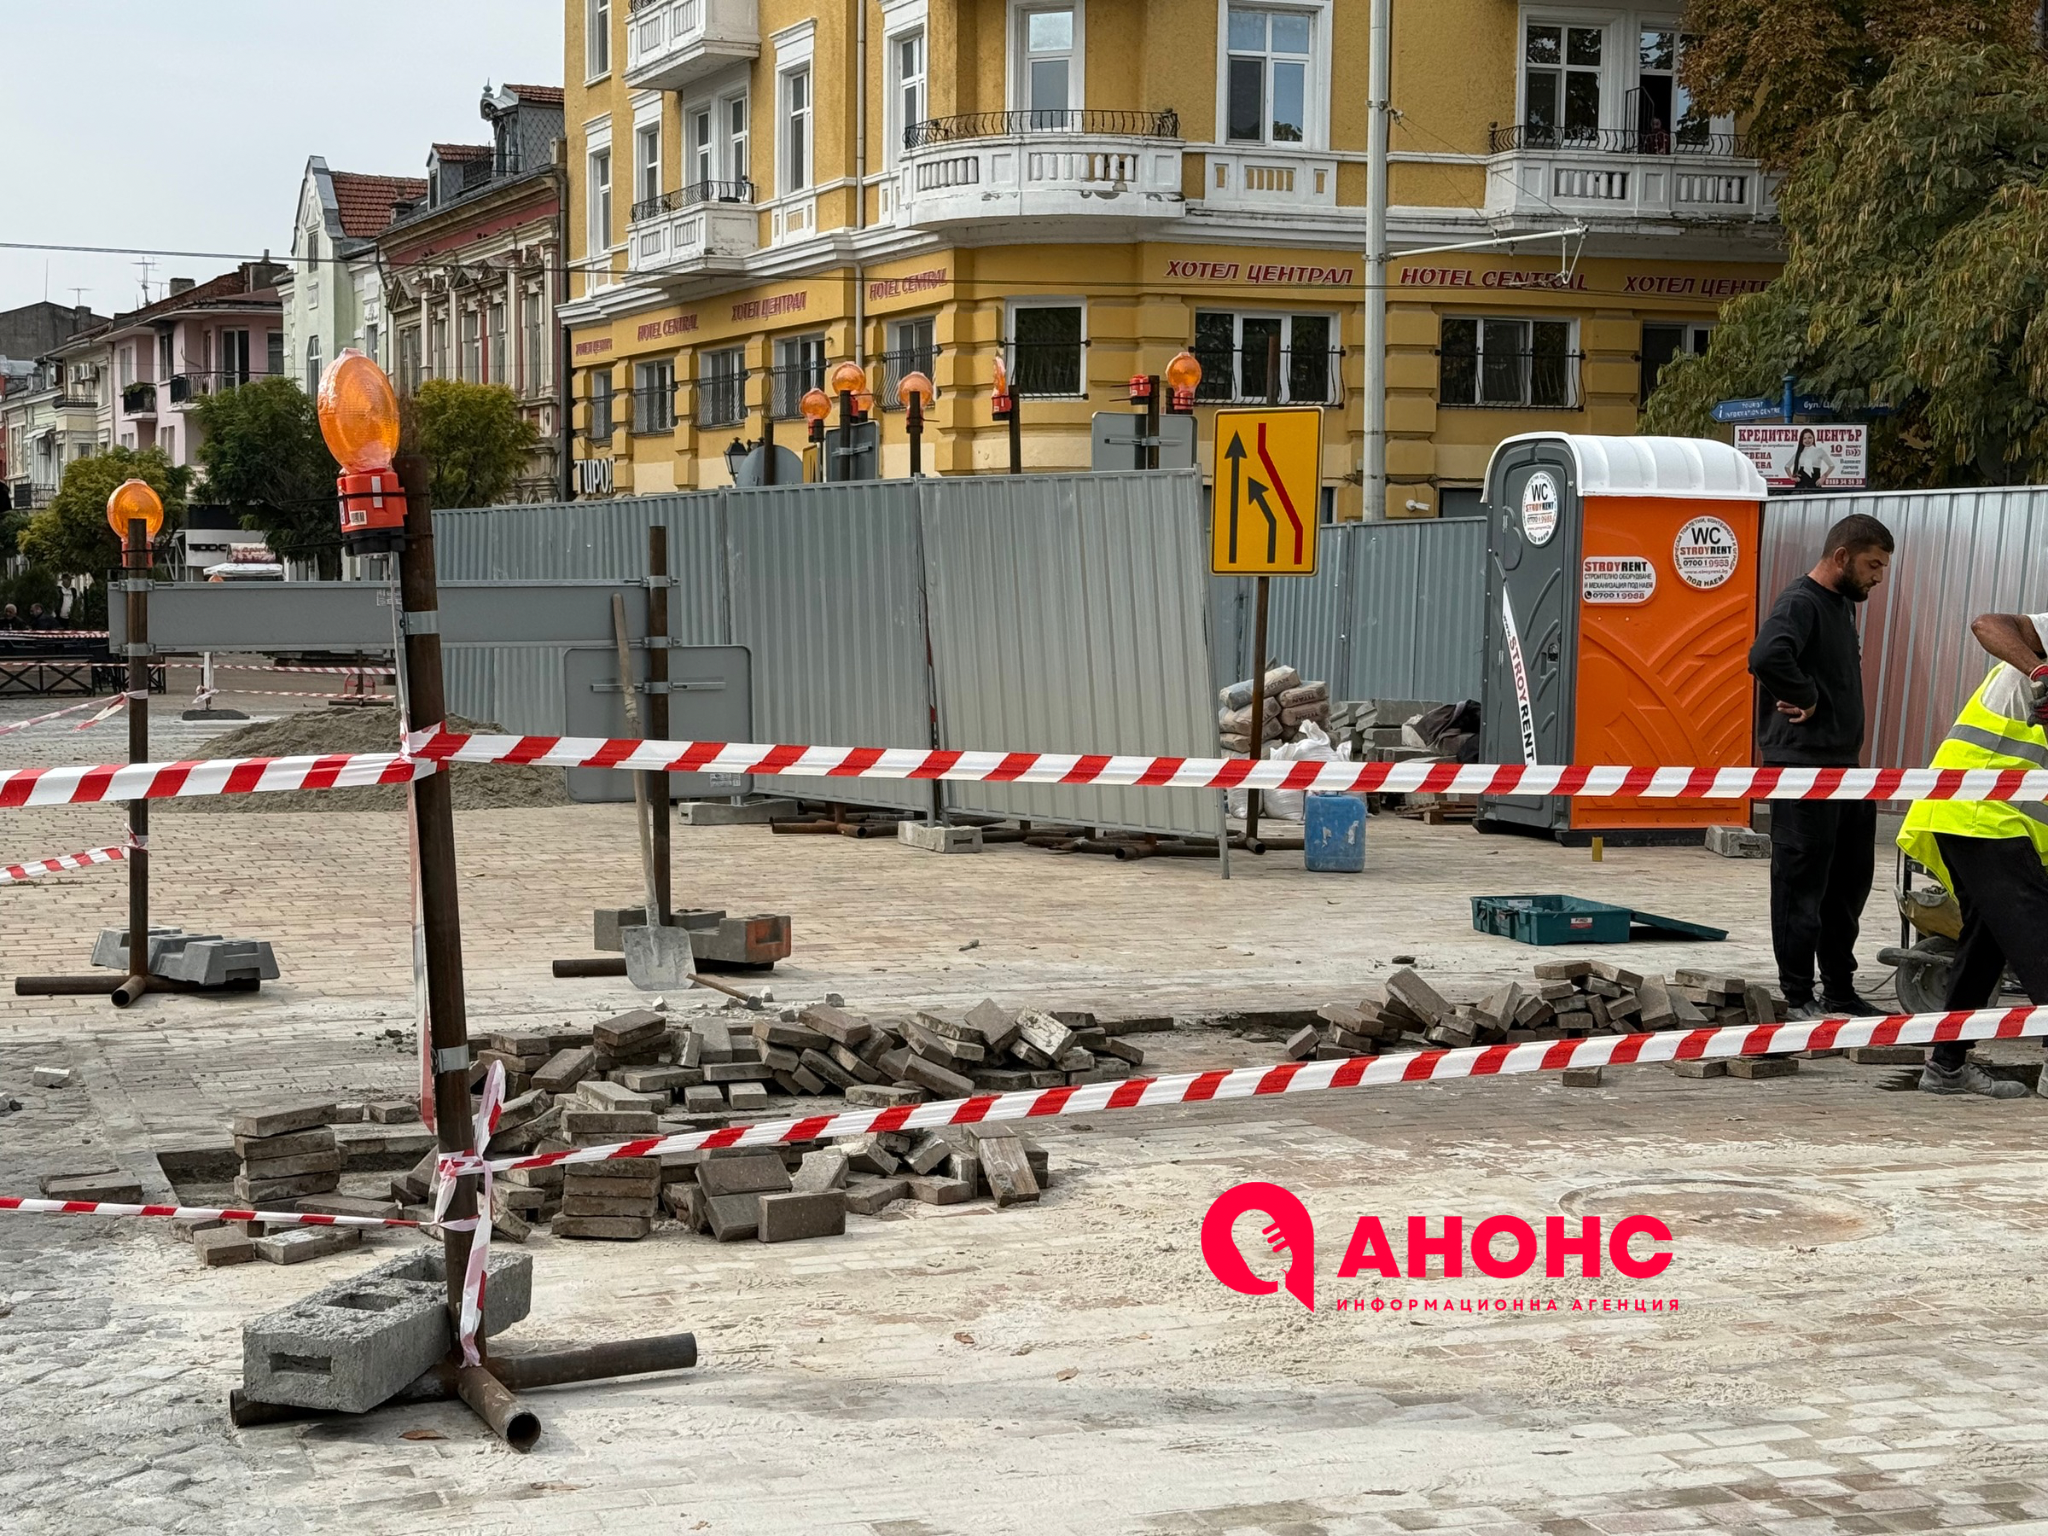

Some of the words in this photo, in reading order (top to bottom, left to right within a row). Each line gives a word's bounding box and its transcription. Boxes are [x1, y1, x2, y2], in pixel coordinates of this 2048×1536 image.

[1165, 260, 1240, 281] ХОТЕЛ
[1246, 264, 1354, 285] ЦЕНТРАЛ
[1400, 268, 1476, 287] HOTEL
[1481, 270, 1588, 291] CENTRAL
[869, 279, 901, 301] HOTEL
[901, 267, 948, 295] CENTRAL
[1623, 276, 1696, 294] ХОТЕЛ
[731, 299, 760, 322] ХОТЕЛ
[760, 290, 808, 321] ЦЕНТРАЛ
[637, 321, 662, 342] HOTEL
[662, 314, 699, 336] CENTRAL
[1738, 429, 1799, 443] КРЕДИТЕН
[1816, 429, 1862, 443] ЦЕНТЪР
[1830, 444, 1843, 453] 10
[1531, 483, 1548, 501] WC
[1691, 527, 1721, 545] WC
[1680, 546, 1732, 556] STROYRENT
[1584, 561, 1648, 572] STROYRENT
[1683, 559, 1703, 567] 0700
[1686, 575, 1702, 587] ПОД
[1703, 574, 1725, 587] НАЕМ
